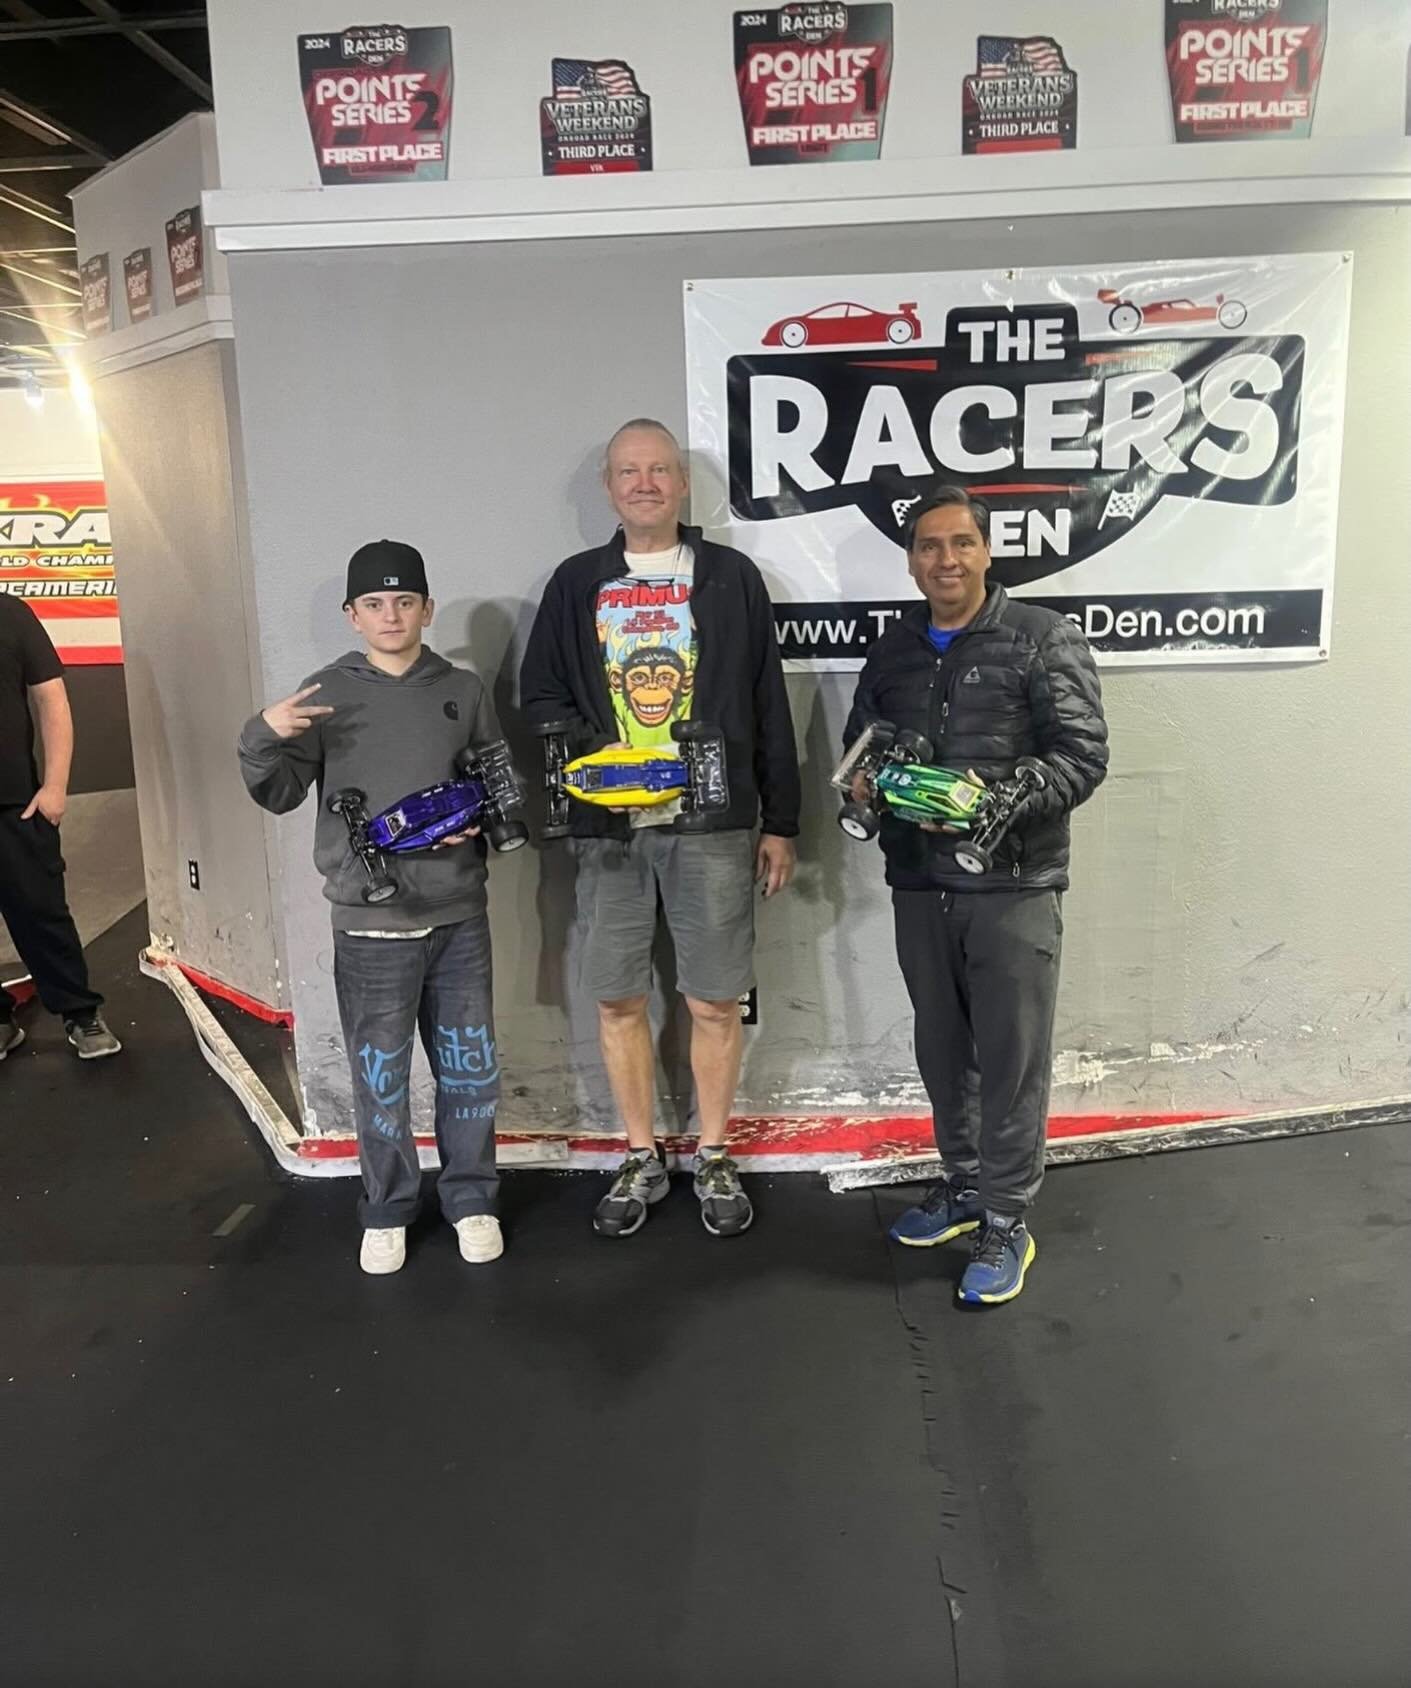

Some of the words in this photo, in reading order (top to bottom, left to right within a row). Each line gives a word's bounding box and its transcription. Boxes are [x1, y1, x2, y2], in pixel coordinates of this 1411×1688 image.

[740, 14, 767, 26] 2024
[781, 12, 845, 33] RACERS
[305, 38, 331, 50] 2024
[344, 35, 405, 55] RACERS
[1180, 26, 1310, 60] POINTS
[750, 47, 876, 83] POINTS
[1195, 56, 1289, 84] SERIES
[1297, 48, 1309, 90] 1
[315, 73, 427, 105] POINTS
[765, 78, 857, 108] SERIES
[863, 67, 877, 112] 1
[970, 76, 1070, 98] VETERANS
[331, 101, 411, 127] SERIES
[412, 90, 440, 131] 2
[547, 99, 645, 118] VETERANS
[979, 92, 1062, 111] WEEKEND
[1180, 102, 1240, 121] FIRST
[1241, 100, 1307, 119] PLACE
[557, 115, 636, 132] WEEKEND
[752, 125, 810, 145] FIRST
[811, 121, 876, 141] PLACE
[979, 123, 1018, 138] THIRD
[1021, 120, 1059, 135] PLACE
[322, 145, 378, 164] FIRST
[379, 143, 442, 162] PLACE
[558, 145, 596, 159] THIRD
[598, 144, 635, 158] PLACE
[958, 317, 1066, 363] THE
[749, 353, 1285, 499] RACERS
[990, 508, 1071, 557] EN
[37, 555, 113, 567] CHAM
[596, 584, 690, 610] PRIMU
